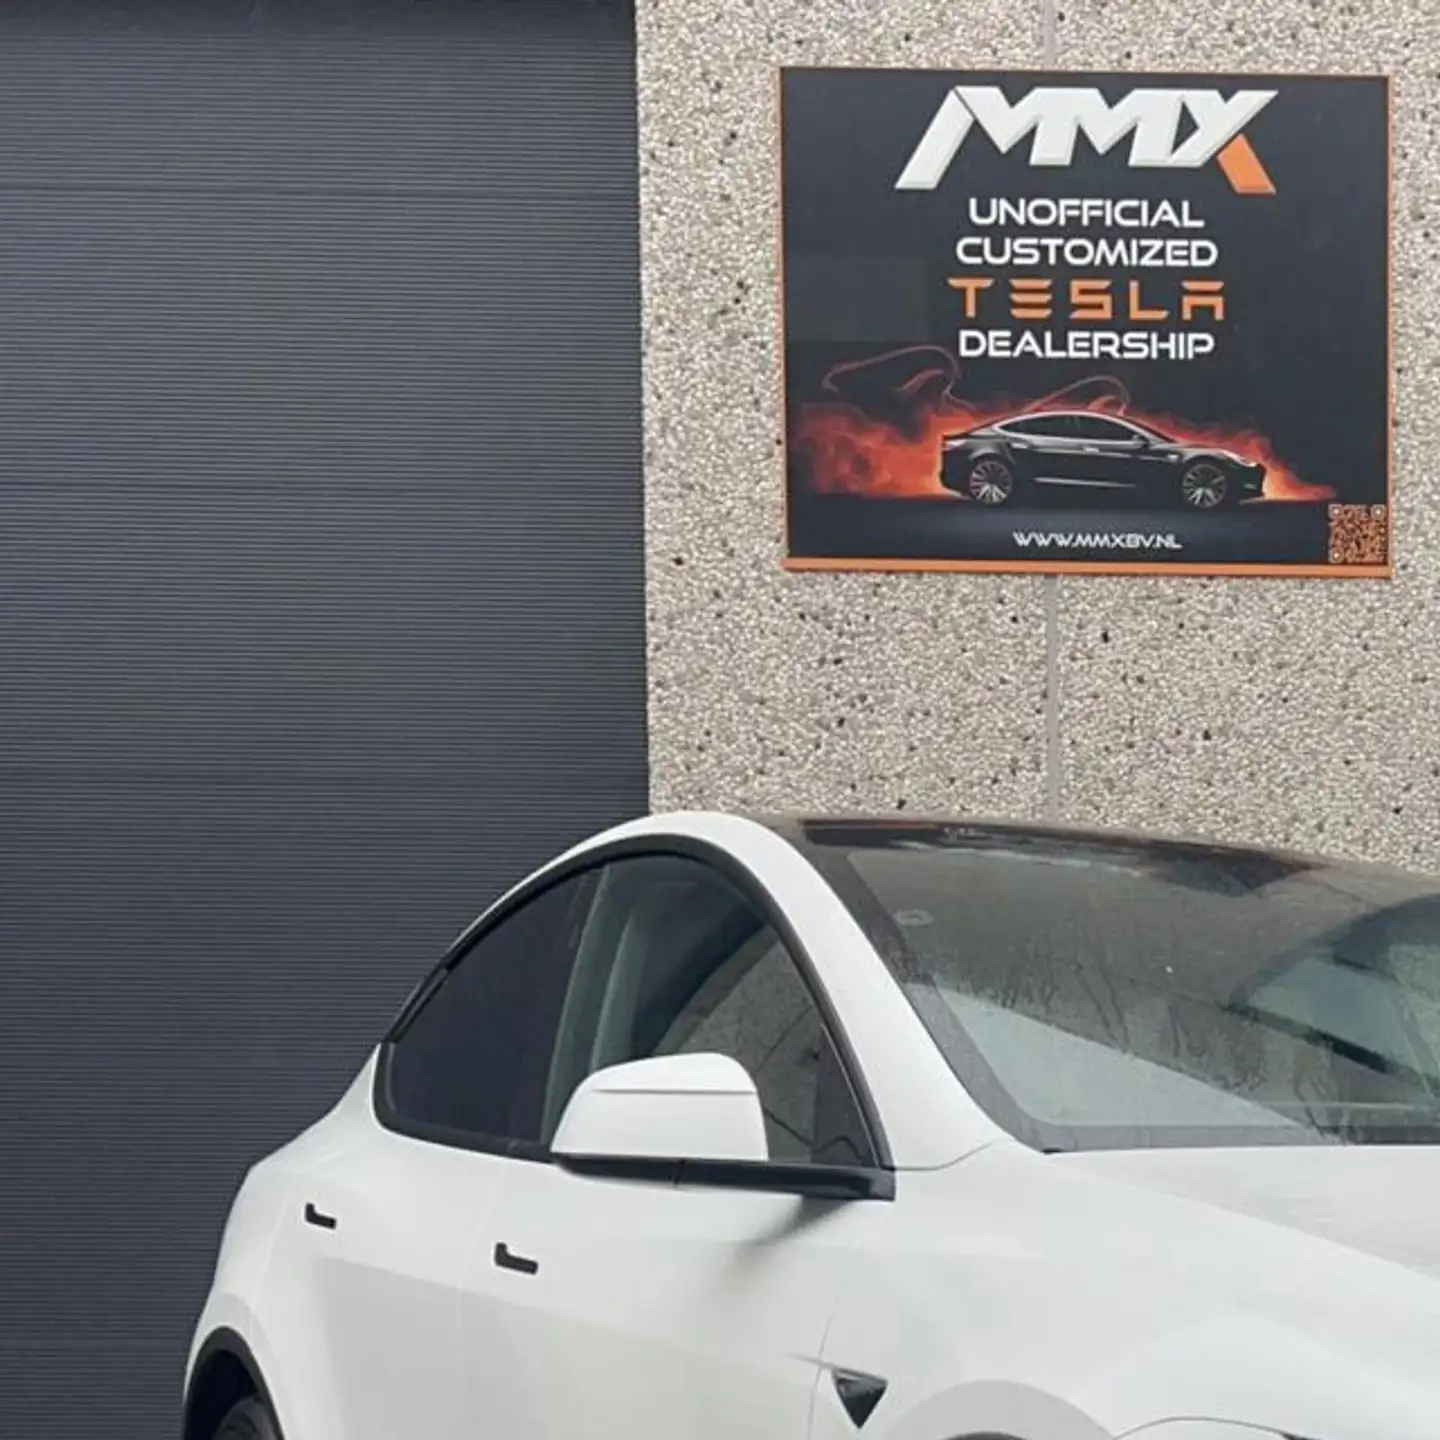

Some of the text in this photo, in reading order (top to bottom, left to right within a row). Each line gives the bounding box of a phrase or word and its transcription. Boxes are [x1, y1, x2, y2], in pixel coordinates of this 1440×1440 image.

[895, 85, 1279, 194] MMX
[969, 198, 1205, 228] UNOFFICIAL
[956, 237, 1218, 267] CUSTOMIZED
[947, 277, 1225, 321] TESLA
[958, 329, 1215, 360] DEALERSHIP
[1012, 530, 1183, 549] WWW.MMXBV.NL
